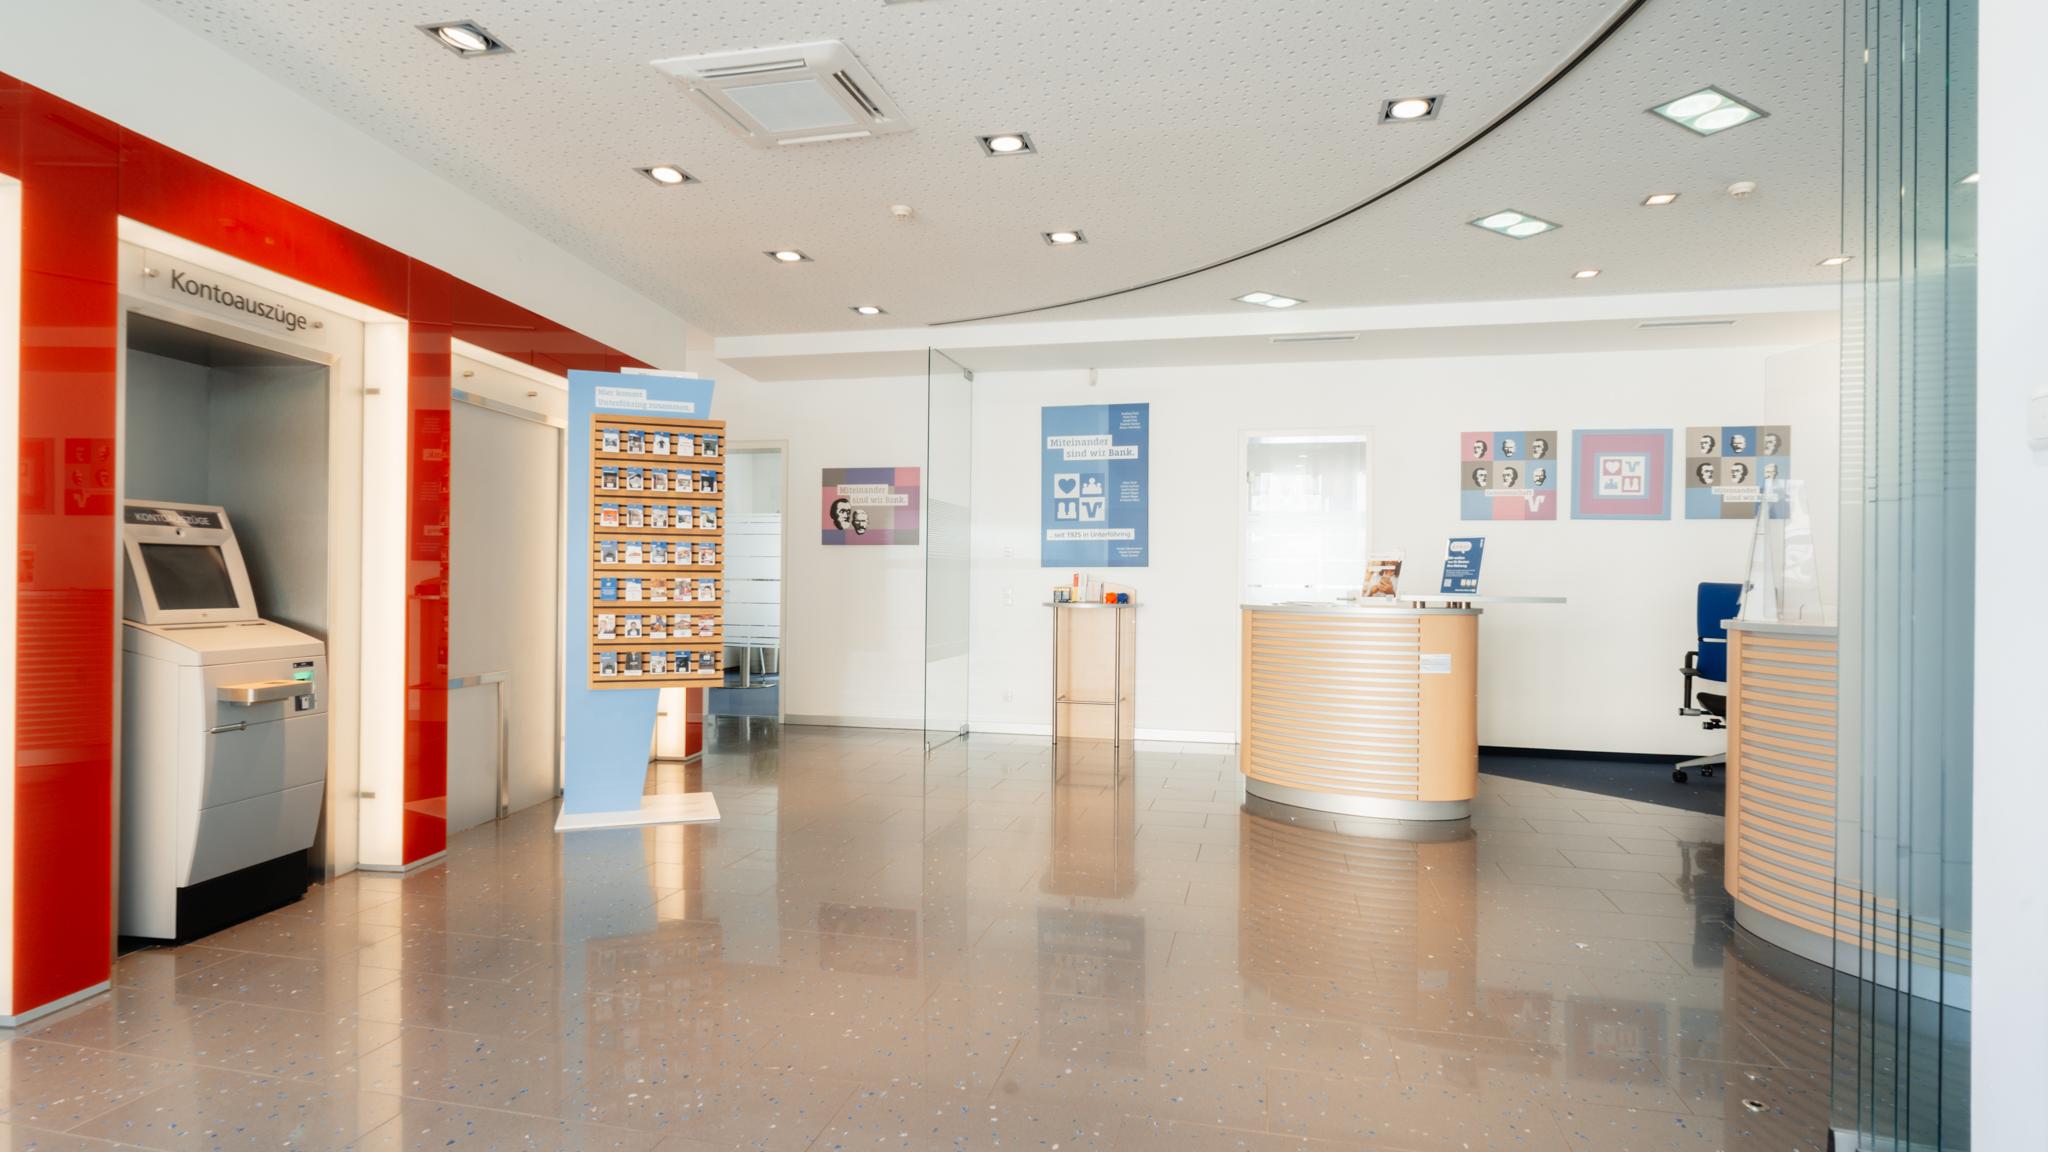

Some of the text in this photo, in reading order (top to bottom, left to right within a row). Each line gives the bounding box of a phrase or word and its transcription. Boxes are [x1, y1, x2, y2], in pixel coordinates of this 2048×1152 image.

[171, 269, 307, 331] Kontoauszüge
[1050, 437, 1109, 448] Miteinander
[1066, 447, 1135, 458] sind wir Bank.
[839, 486, 886, 494] Miteinander
[1090, 530, 1131, 538] Unterföhring
